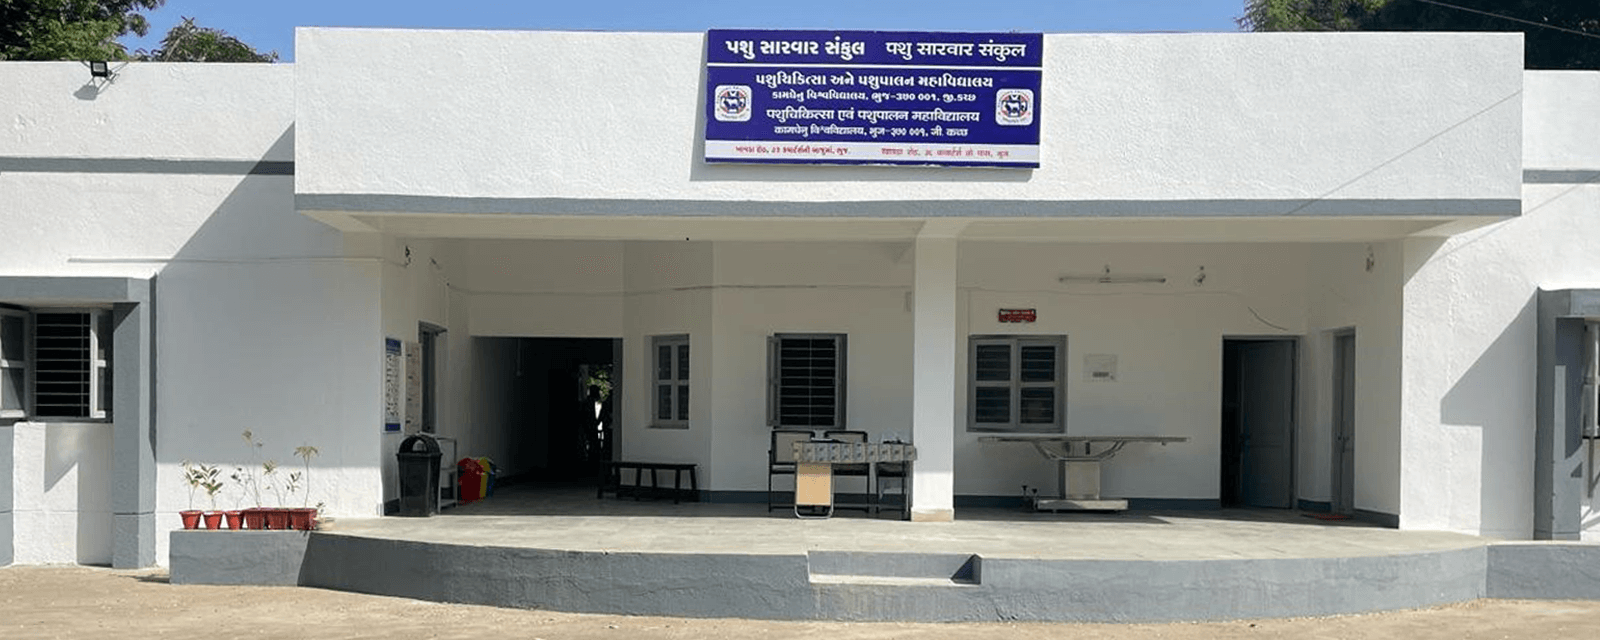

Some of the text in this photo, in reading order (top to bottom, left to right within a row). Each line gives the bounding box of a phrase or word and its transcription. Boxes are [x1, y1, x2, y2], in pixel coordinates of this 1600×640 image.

[726, 36, 865, 60] પશુ સારવાર સંકુલ
[886, 39, 1027, 60] पशु सारवार संकुल
[755, 73, 827, 89] પશુચિકિત્સા
[829, 73, 855, 86] અને
[859, 75, 915, 90] પશુપાલન
[772, 89, 804, 102] કામધેનુ
[766, 105, 981, 124] पशुचिकित्सा एवं पशुपालन महाविद्यालय
[774, 123, 809, 138] कामधेनु
